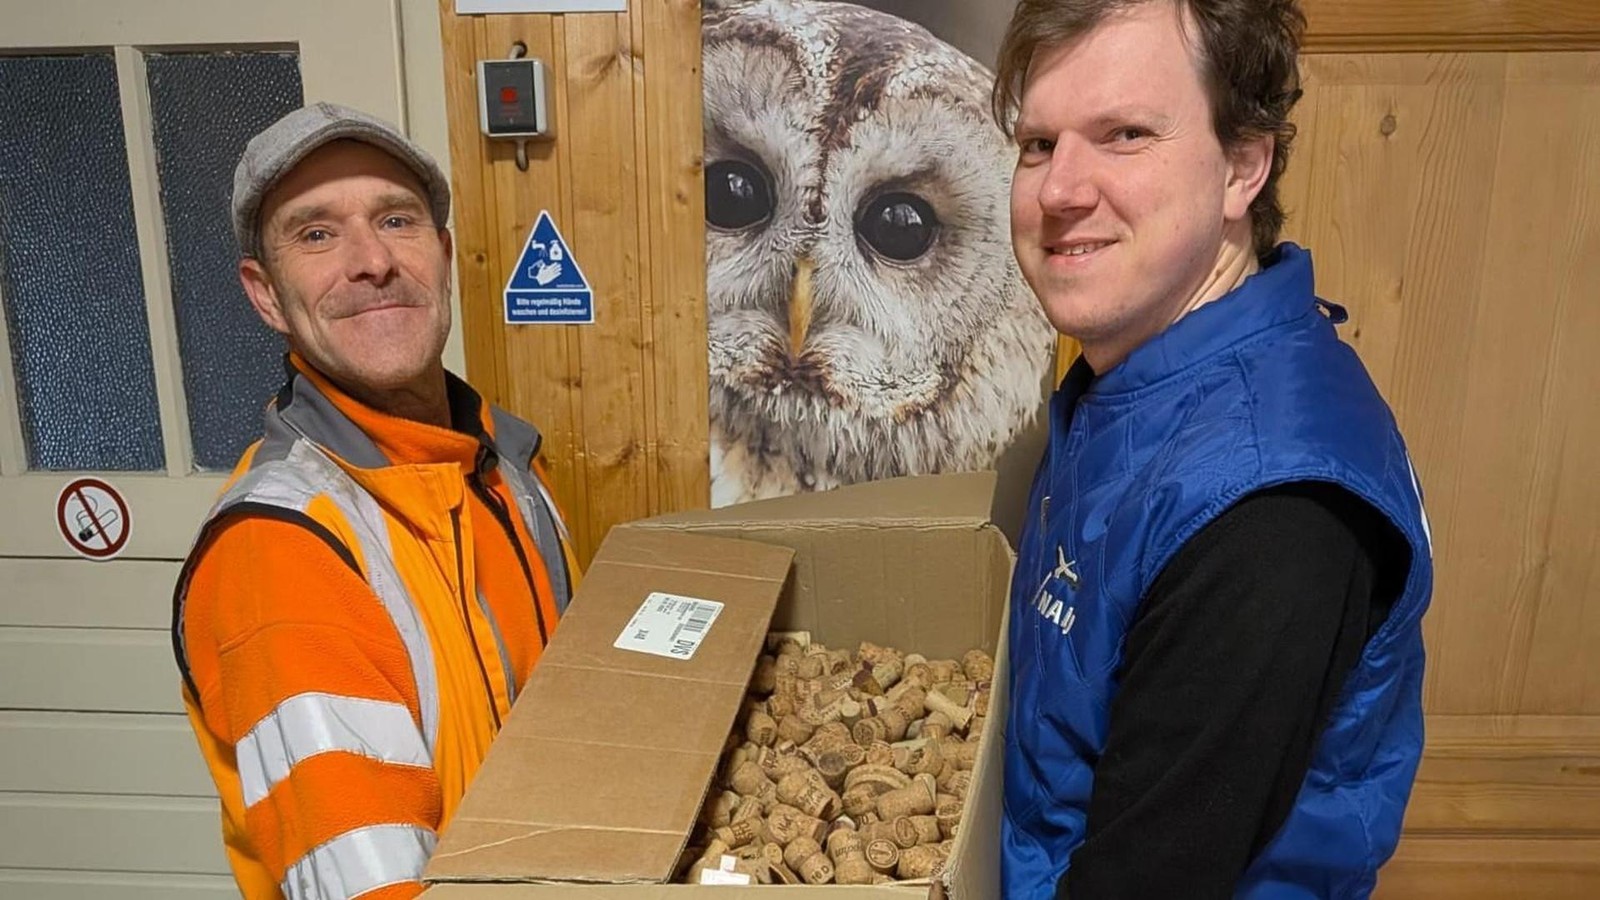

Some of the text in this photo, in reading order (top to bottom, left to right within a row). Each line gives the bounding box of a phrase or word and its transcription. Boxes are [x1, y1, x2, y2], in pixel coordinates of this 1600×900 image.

[516, 297, 581, 307] Bitte regelmäßig Hände
[512, 308, 537, 316] waschen
[537, 308, 549, 316] und
[670, 639, 696, 656] DVS
